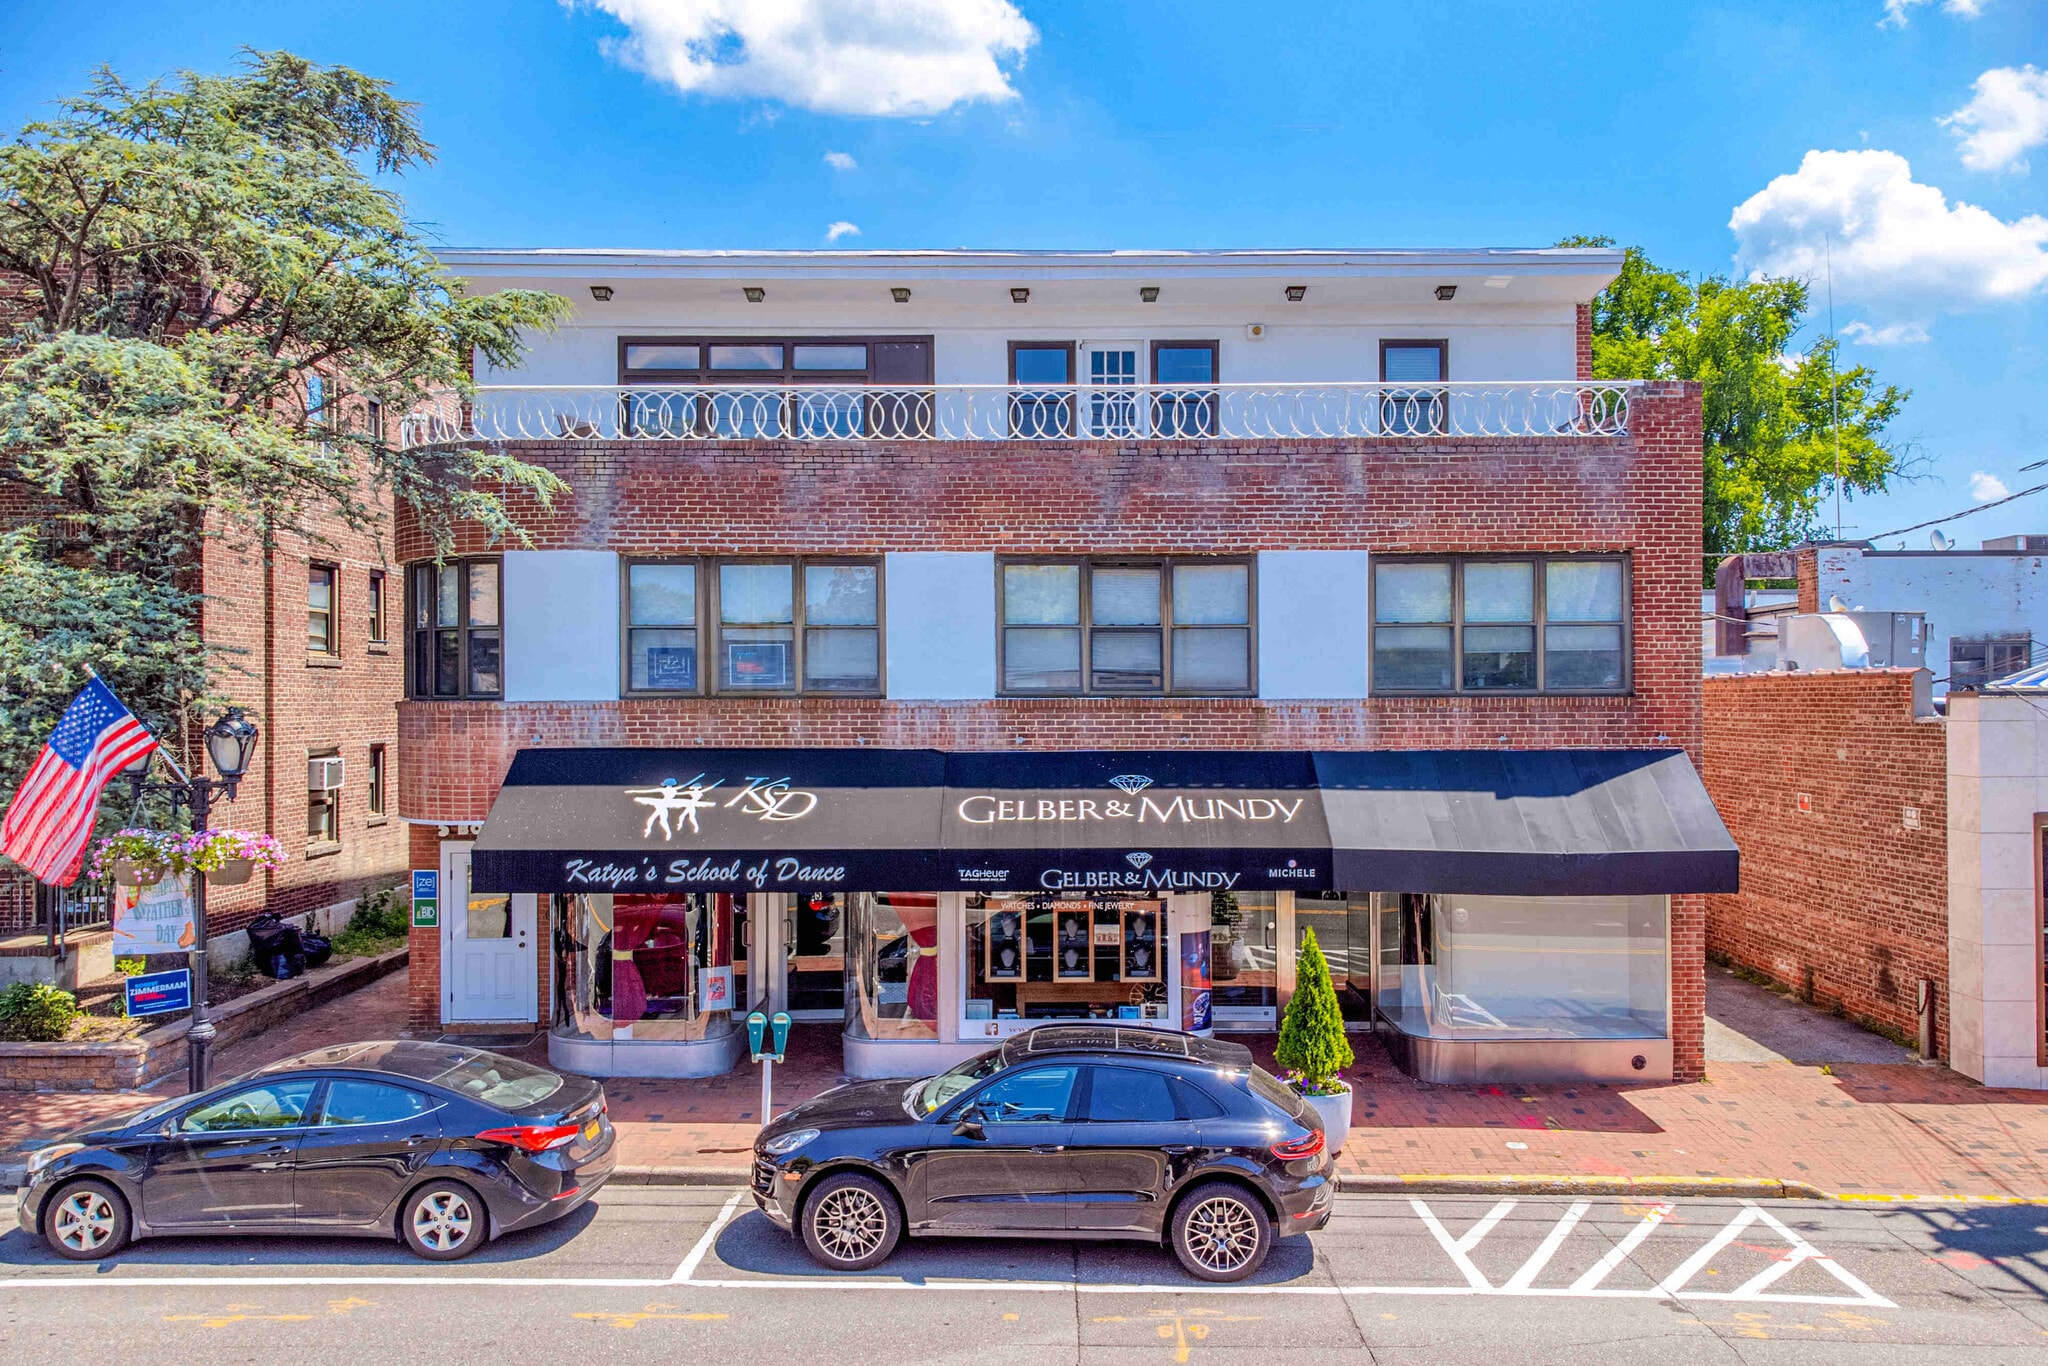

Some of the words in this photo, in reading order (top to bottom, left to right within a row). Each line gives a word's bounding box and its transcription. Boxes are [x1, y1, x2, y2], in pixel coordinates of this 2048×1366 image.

[958, 796, 1104, 823] GELBER
[1137, 796, 1304, 823] MUNDY
[566, 857, 658, 888] Katya's
[665, 857, 741, 883] School
[746, 858, 769, 889] of
[776, 857, 846, 882] Dance
[1040, 869, 1124, 890] GELBER
[1142, 869, 1241, 890] MUNDY
[1268, 868, 1316, 878] MICHELE
[1001, 901, 1035, 910] WATCHES
[1042, 901, 1081, 910] DIAMONDS
[1088, 901, 1104, 910] FINE
[1104, 901, 1136, 911] JEWELRY
[156, 924, 177, 943] DAY
[129, 981, 187, 996] ZIMMERMAN
